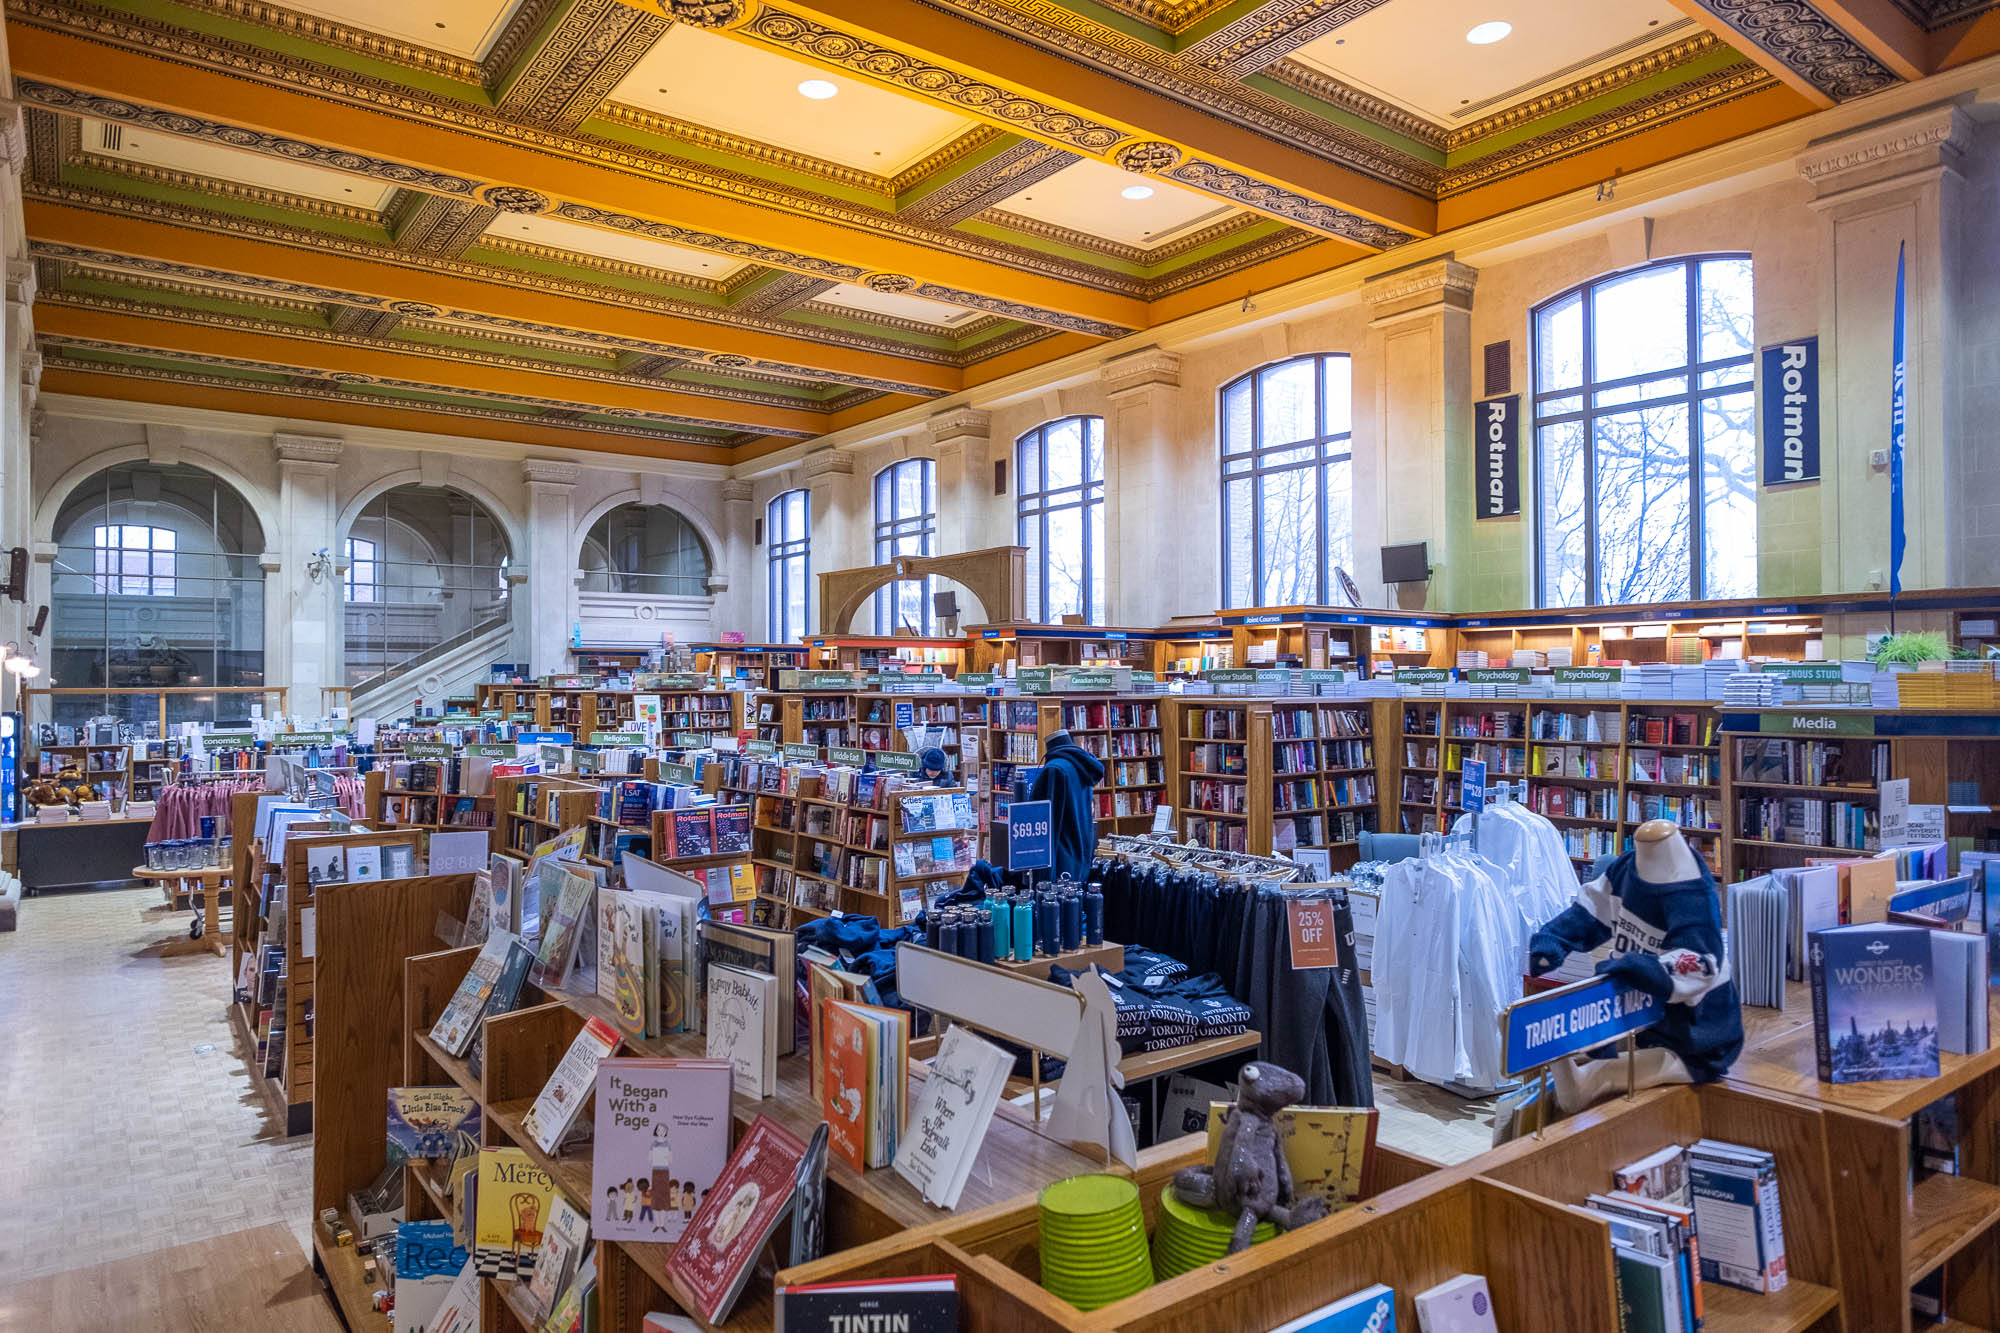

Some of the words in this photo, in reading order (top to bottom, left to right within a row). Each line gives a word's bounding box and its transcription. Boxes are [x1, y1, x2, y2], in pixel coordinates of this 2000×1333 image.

[1783, 344, 1807, 481] Rotman
[1488, 402, 1505, 515] Rotman
[1246, 616, 1258, 624] Joint
[968, 675, 985, 683] French
[1035, 670, 1044, 679] Prep
[1072, 676, 1094, 684] Canadian
[1094, 676, 1111, 684] Politics
[1211, 673, 1232, 681] Gender
[1232, 672, 1253, 681] Studies
[1258, 672, 1282, 682] ociology
[1310, 672, 1336, 682] Sociology
[1398, 671, 1446, 681] Anthropology
[1476, 671, 1520, 681] Psychology
[1563, 670, 1611, 681] Psychology
[1026, 682, 1041, 690] TOEFL
[625, 722, 647, 732] LOVE
[1792, 717, 1837, 729] Media
[204, 736, 241, 745] conomics
[281, 734, 326, 743] Engineering
[604, 734, 630, 744] Religion
[413, 746, 445, 756] Mythology
[480, 748, 504, 756] Classics
[786, 746, 797, 755] Latin
[797, 747, 816, 757] America
[834, 751, 849, 760] Middle
[850, 752, 860, 762] East
[880, 754, 894, 764] Asian
[894, 756, 914, 768] History
[670, 768, 682, 780] LSAT
[900, 796, 922, 805] Cities
[676, 814, 709, 823] Rotman
[716, 811, 748, 820] Rotman
[1012, 821, 1048, 840] $69.99
[1298, 911, 1325, 928] 25%
[1302, 927, 1323, 944] OFF
[1151, 963, 1188, 976] RONTO
[1835, 964, 1924, 985] WONDERS
[1151, 1004, 1185, 1014] UNIVERSITY
[1201, 1008, 1234, 1016] UNIVERSITY
[1116, 1010, 1150, 1022] RONTO
[1150, 1009, 1200, 1026] TORONTO
[1525, 1012, 1568, 1050] TRAVEL
[1570, 997, 1611, 1034] GUIDES
[1614, 995, 1622, 1018] &
[1624, 992, 1654, 1015] MAPS
[1116, 1026, 1146, 1038] ONTO
[1144, 1034, 1195, 1051] TORONTO
[610, 1076, 621, 1089] It
[414, 1093, 432, 1102] Good
[623, 1084, 668, 1101] Began
[402, 1104, 424, 1114] Little
[424, 1102, 442, 1112] Blue
[442, 1102, 466, 1114] Truck
[608, 1098, 644, 1112] With
[648, 1102, 657, 1112] a
[934, 1096, 956, 1121] Where
[614, 1113, 650, 1131] Page
[920, 1138, 938, 1160] Ends
[492, 1162, 556, 1192] Mercy
[1692, 1184, 1735, 1201] SHANGHAI
[1763, 1188, 1776, 1242] EUROPE
[422, 1231, 444, 1239] Michael
[829, 1314, 909, 1333] TINTIN
